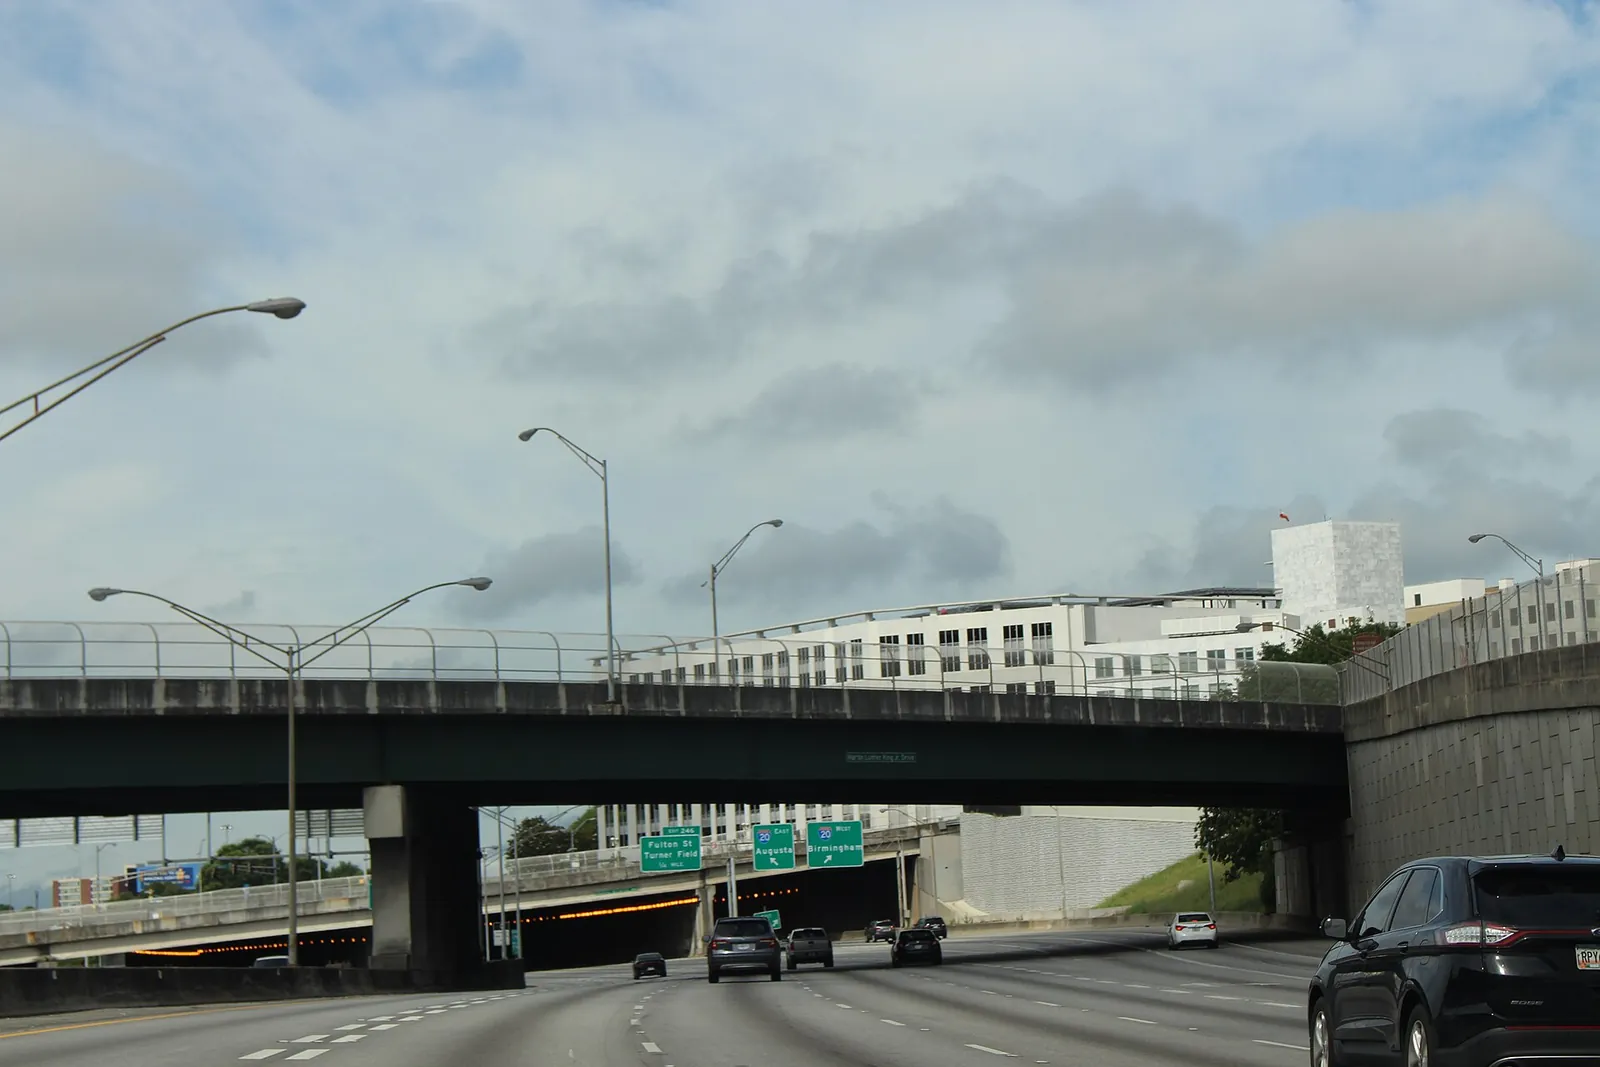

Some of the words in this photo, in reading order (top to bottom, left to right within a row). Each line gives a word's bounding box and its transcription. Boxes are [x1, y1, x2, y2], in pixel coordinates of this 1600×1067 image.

[759, 833, 770, 841] 20
[821, 830, 831, 838] 20
[755, 847, 793, 856] Augusta
[808, 844, 862, 853] Birmingham
[644, 851, 672, 859] Turner
[677, 850, 698, 858] Field
